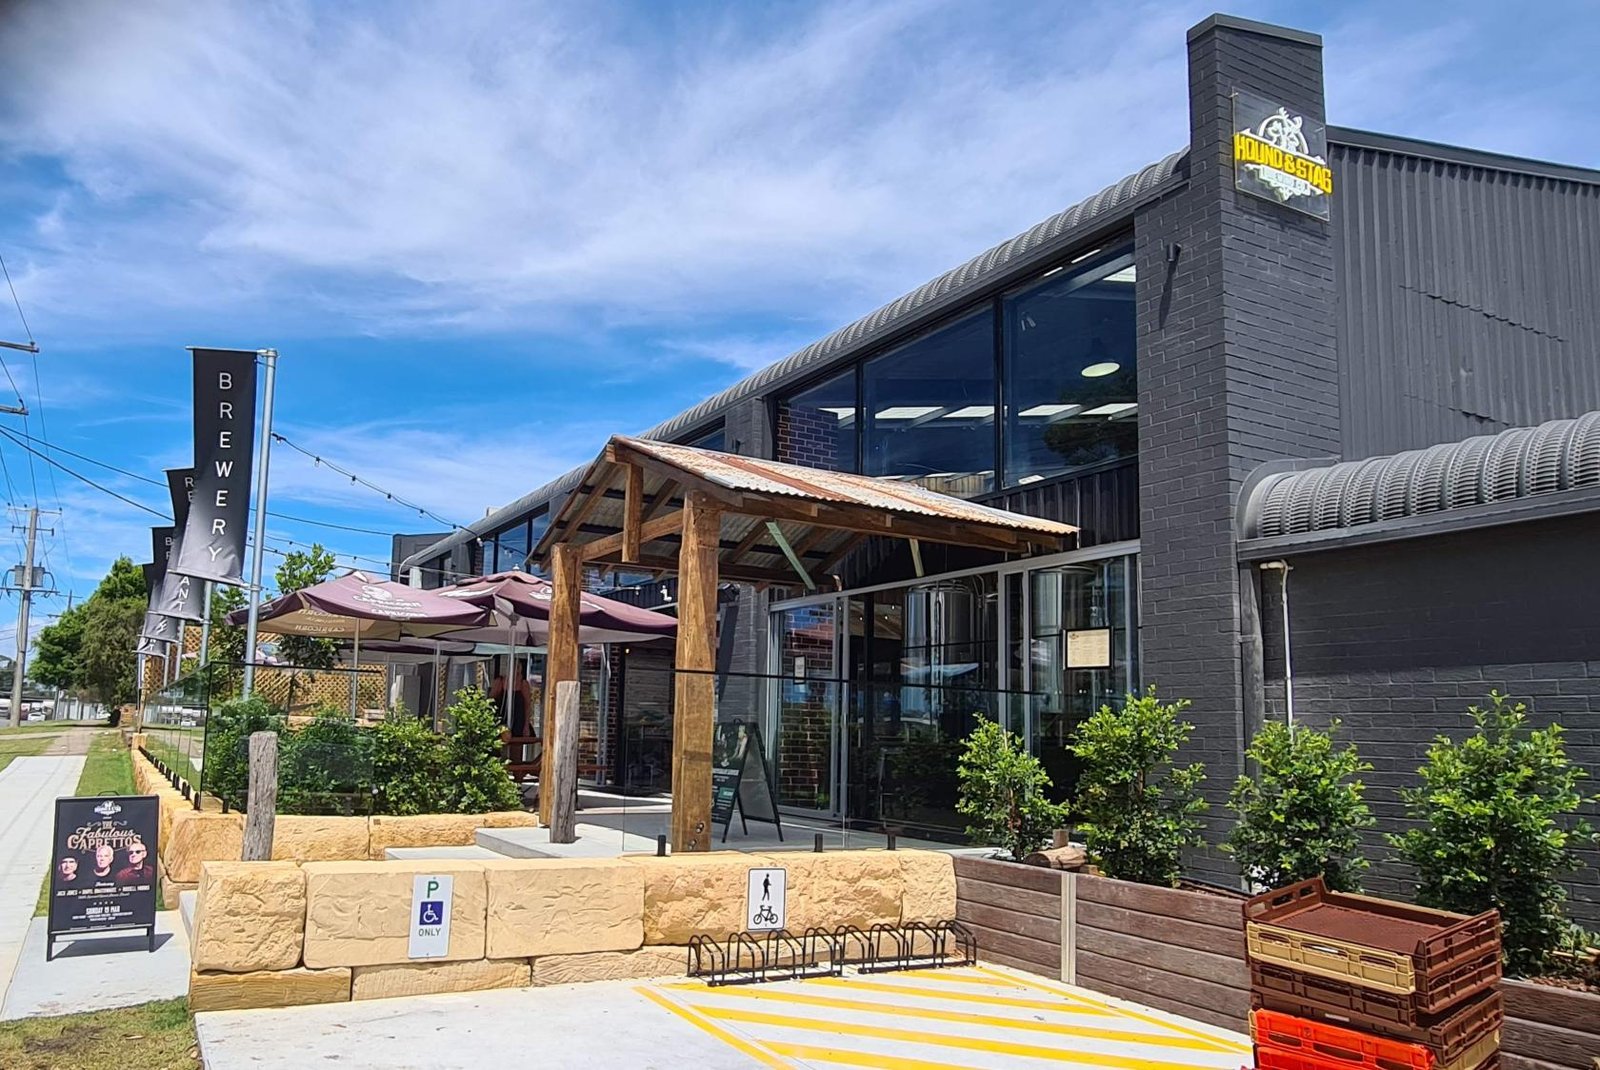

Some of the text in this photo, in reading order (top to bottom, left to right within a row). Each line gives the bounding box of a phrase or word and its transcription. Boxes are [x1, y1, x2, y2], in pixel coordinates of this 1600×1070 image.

[1234, 133, 1283, 169] HOUND
[1285, 154, 1297, 173] &
[1296, 159, 1332, 193] STAG
[208, 372, 233, 562] BREWERY
[67, 834, 142, 850] CAPRETTOS
[76, 827, 135, 843] Fabulous
[427, 881, 439, 898] P
[418, 928, 441, 937] ONLY
